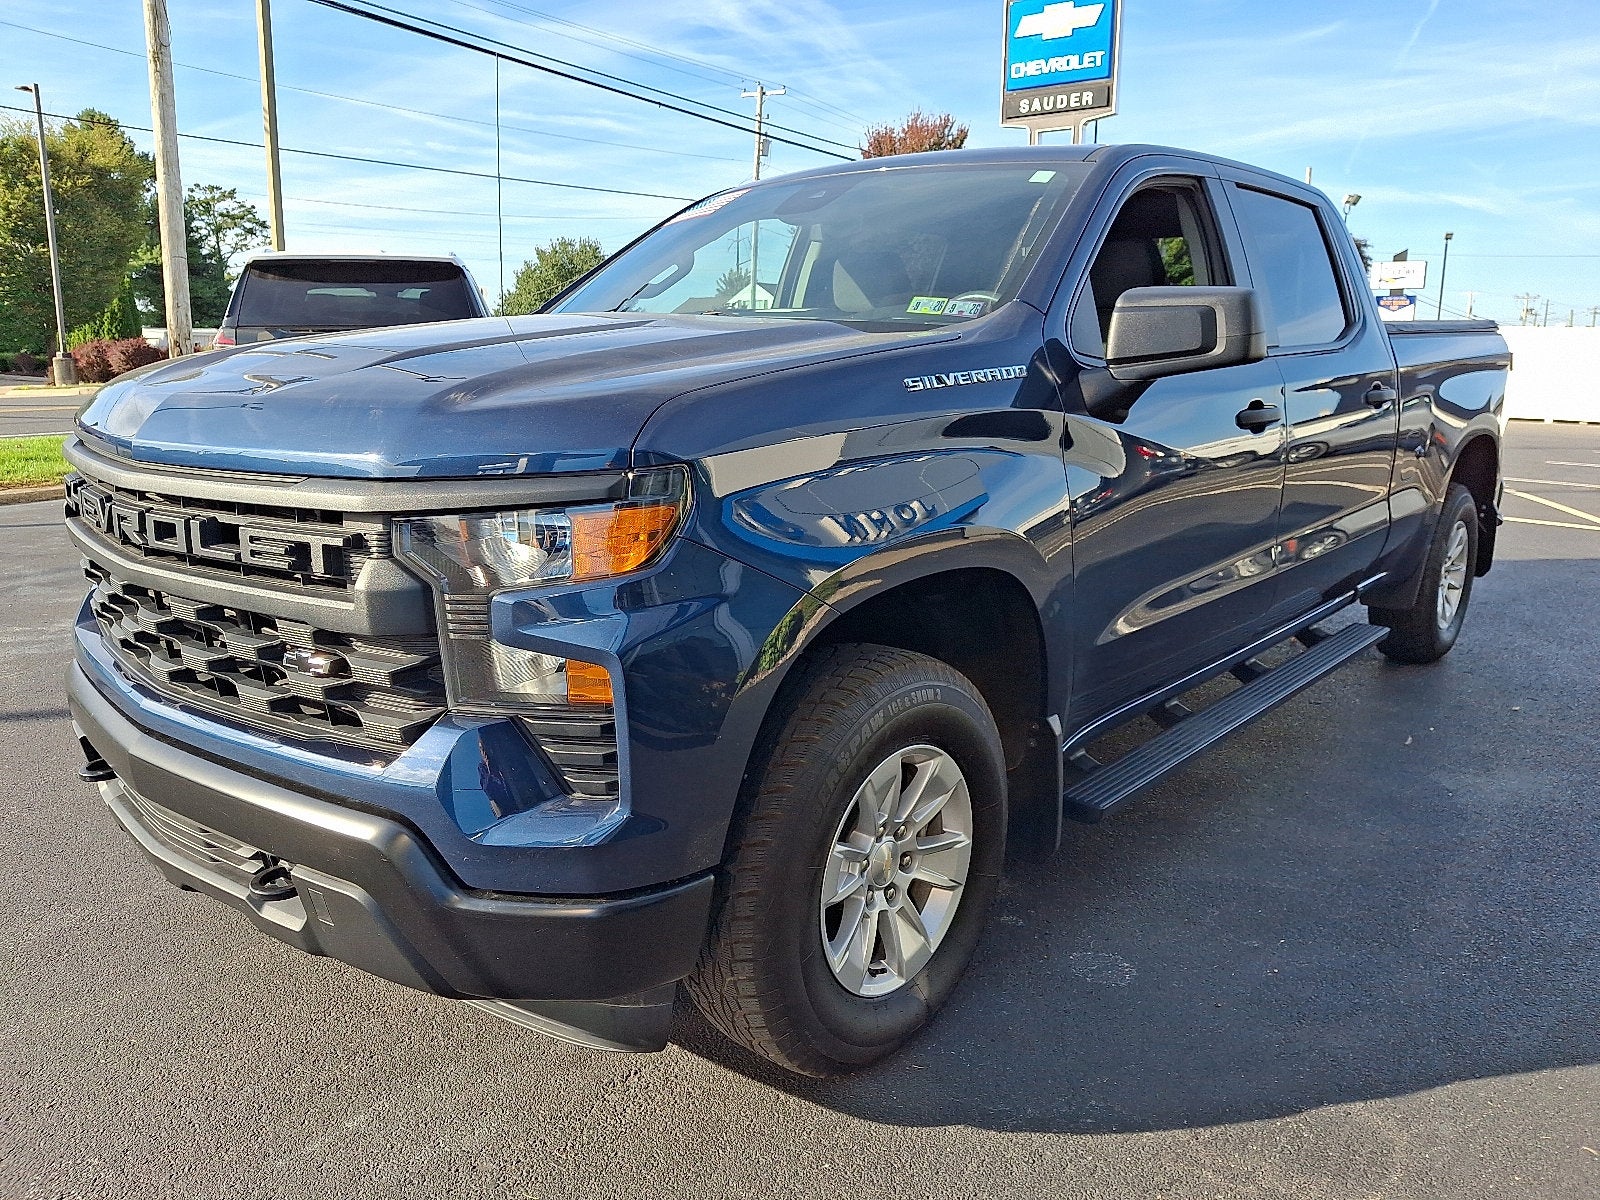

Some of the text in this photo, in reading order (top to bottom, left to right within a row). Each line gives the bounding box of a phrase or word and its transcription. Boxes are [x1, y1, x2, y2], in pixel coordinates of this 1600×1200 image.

[1010, 50, 1106, 79] CHEVROLET
[1019, 91, 1094, 113] SAUDER
[903, 365, 1028, 392] SILVERADO
[911, 688, 934, 704] SNOW
